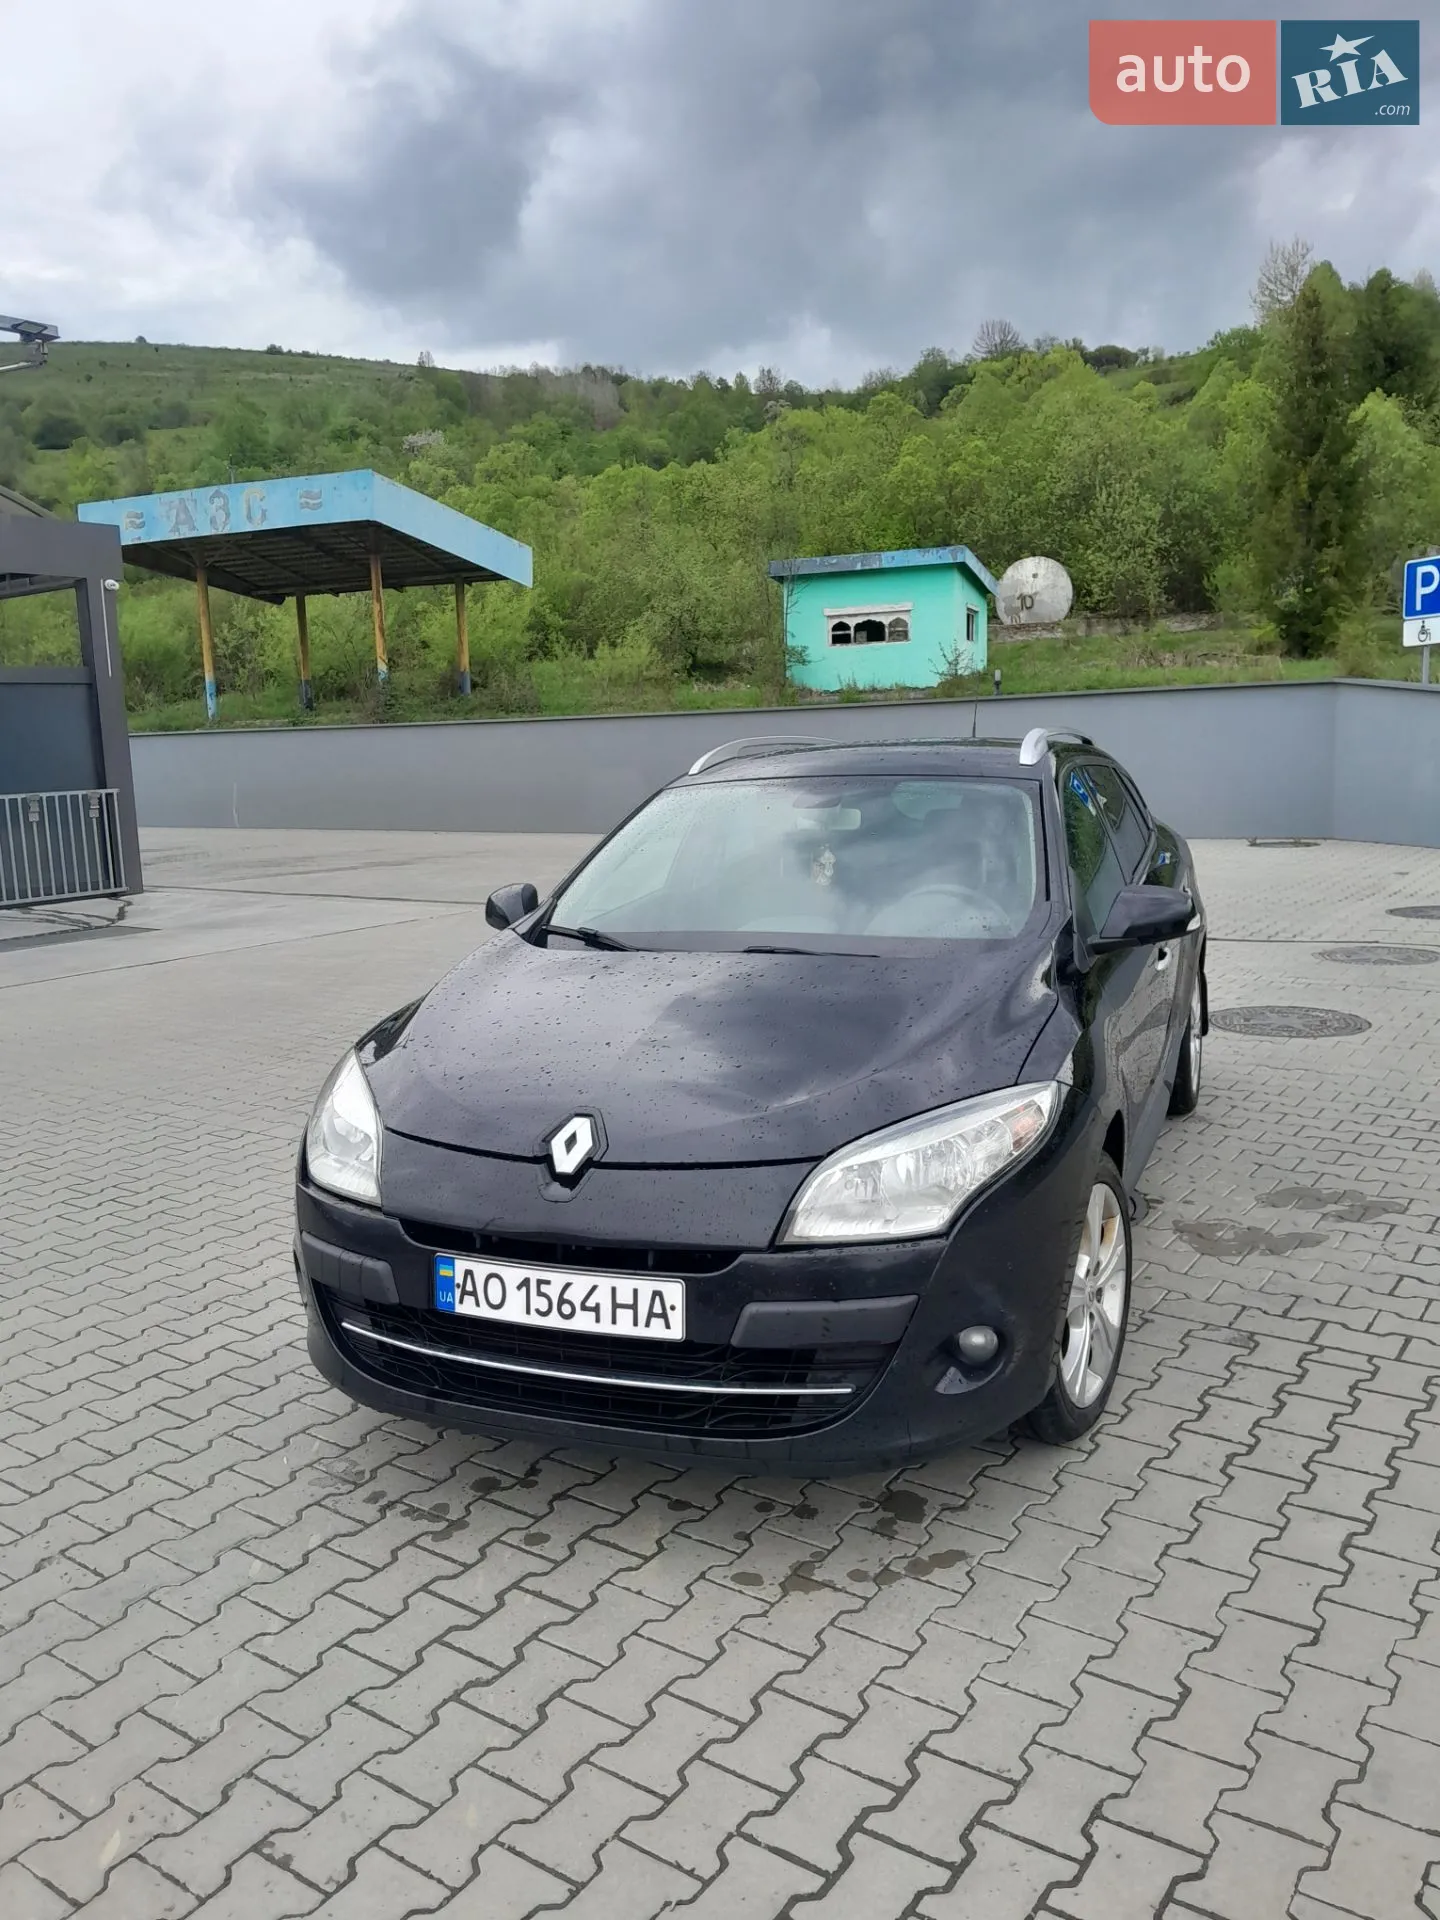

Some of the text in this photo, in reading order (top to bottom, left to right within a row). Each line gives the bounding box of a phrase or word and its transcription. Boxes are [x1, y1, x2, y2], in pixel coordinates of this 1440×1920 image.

[1017, 592, 1034, 611] 10
[1415, 564, 1440, 611] P
[439, 1290, 454, 1304] UA
[458, 1268, 507, 1311] AO
[515, 1276, 601, 1325] 1564
